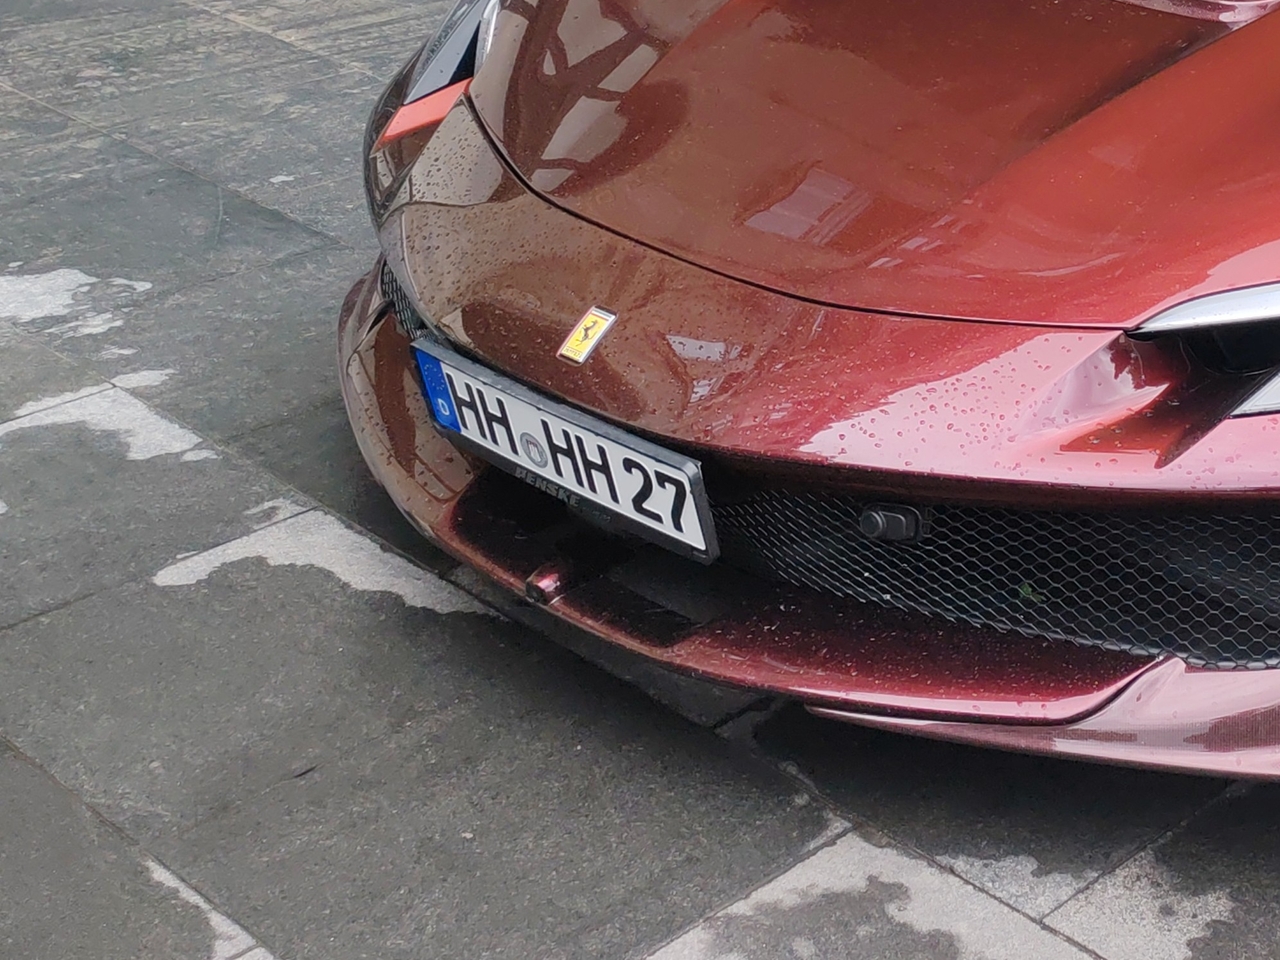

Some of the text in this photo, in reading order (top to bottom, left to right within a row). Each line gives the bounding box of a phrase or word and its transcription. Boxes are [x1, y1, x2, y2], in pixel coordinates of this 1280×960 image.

[437, 397, 450, 416] D
[445, 371, 685, 534] HH HH 27
